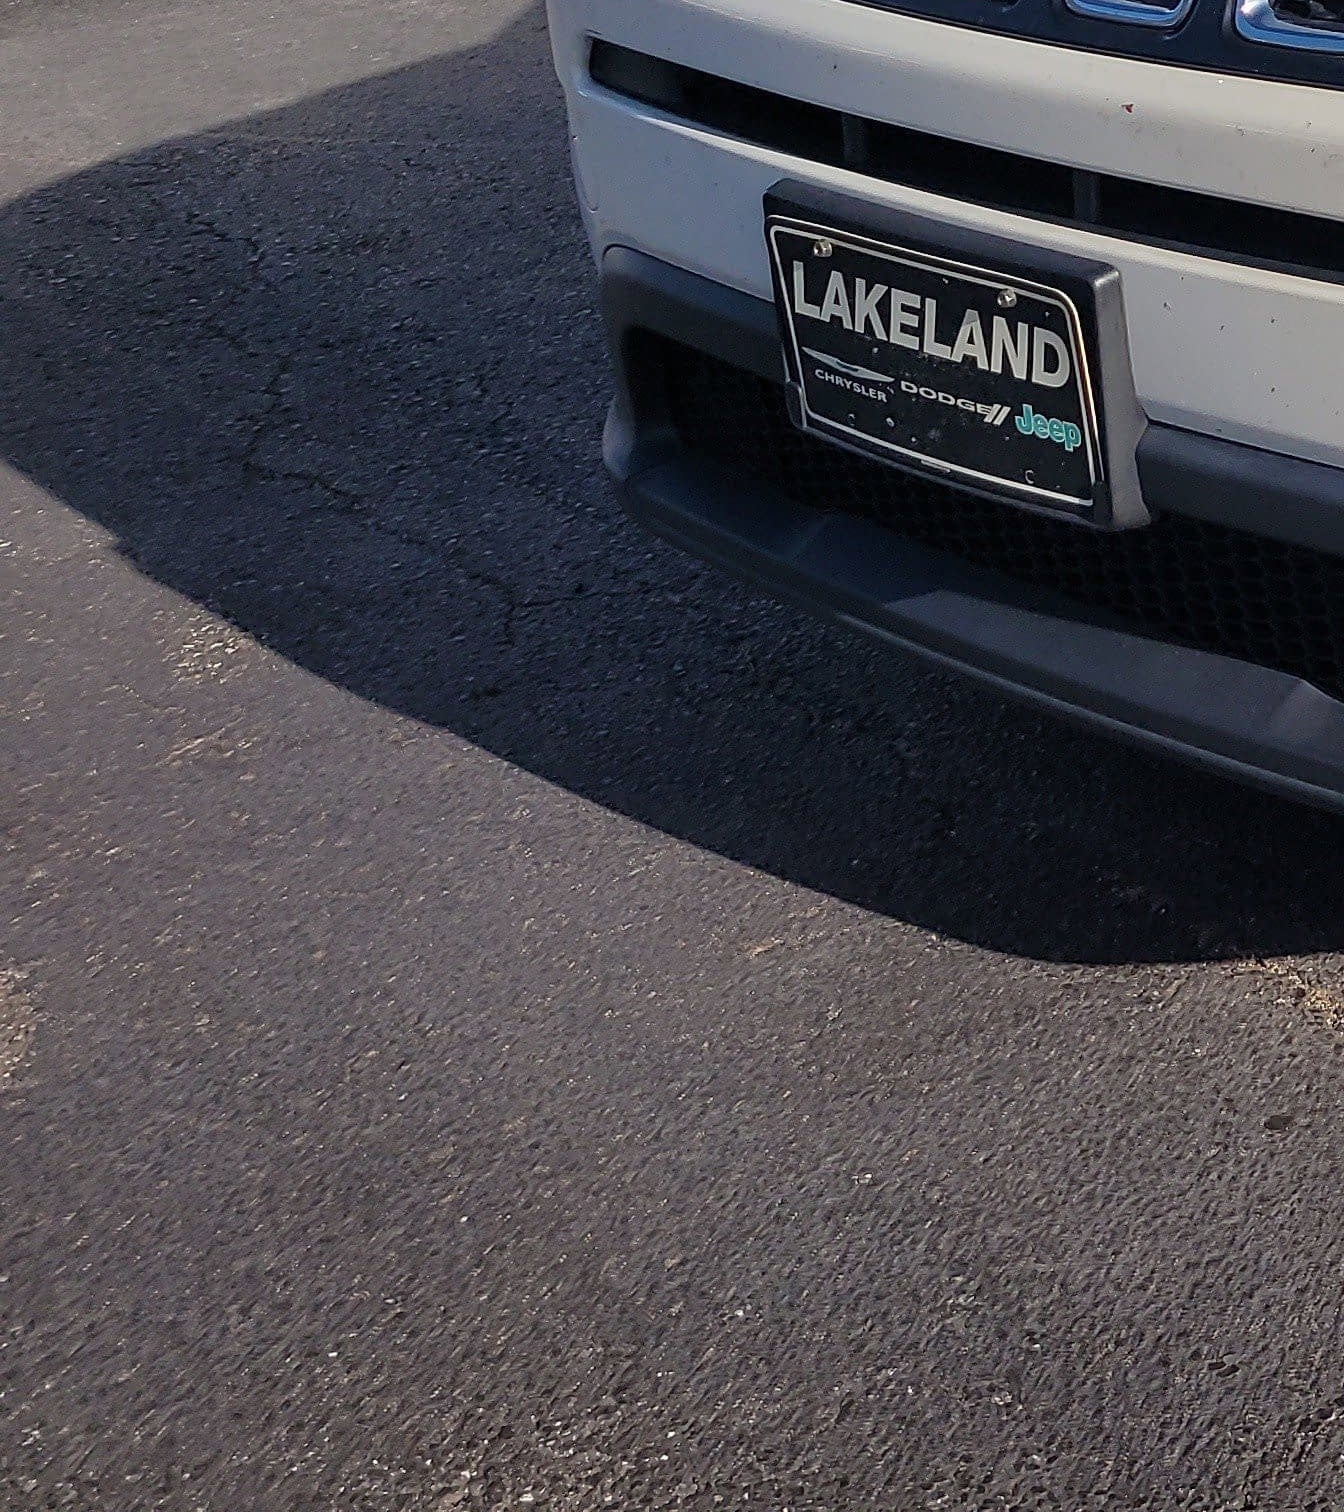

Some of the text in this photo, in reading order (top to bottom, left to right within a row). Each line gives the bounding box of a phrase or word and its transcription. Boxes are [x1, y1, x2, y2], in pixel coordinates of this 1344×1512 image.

[793, 261, 1071, 388] LAKELAND
[815, 369, 888, 403] CHRYSLER
[901, 380, 992, 417] DODGE
[1015, 404, 1081, 452] Jeep
